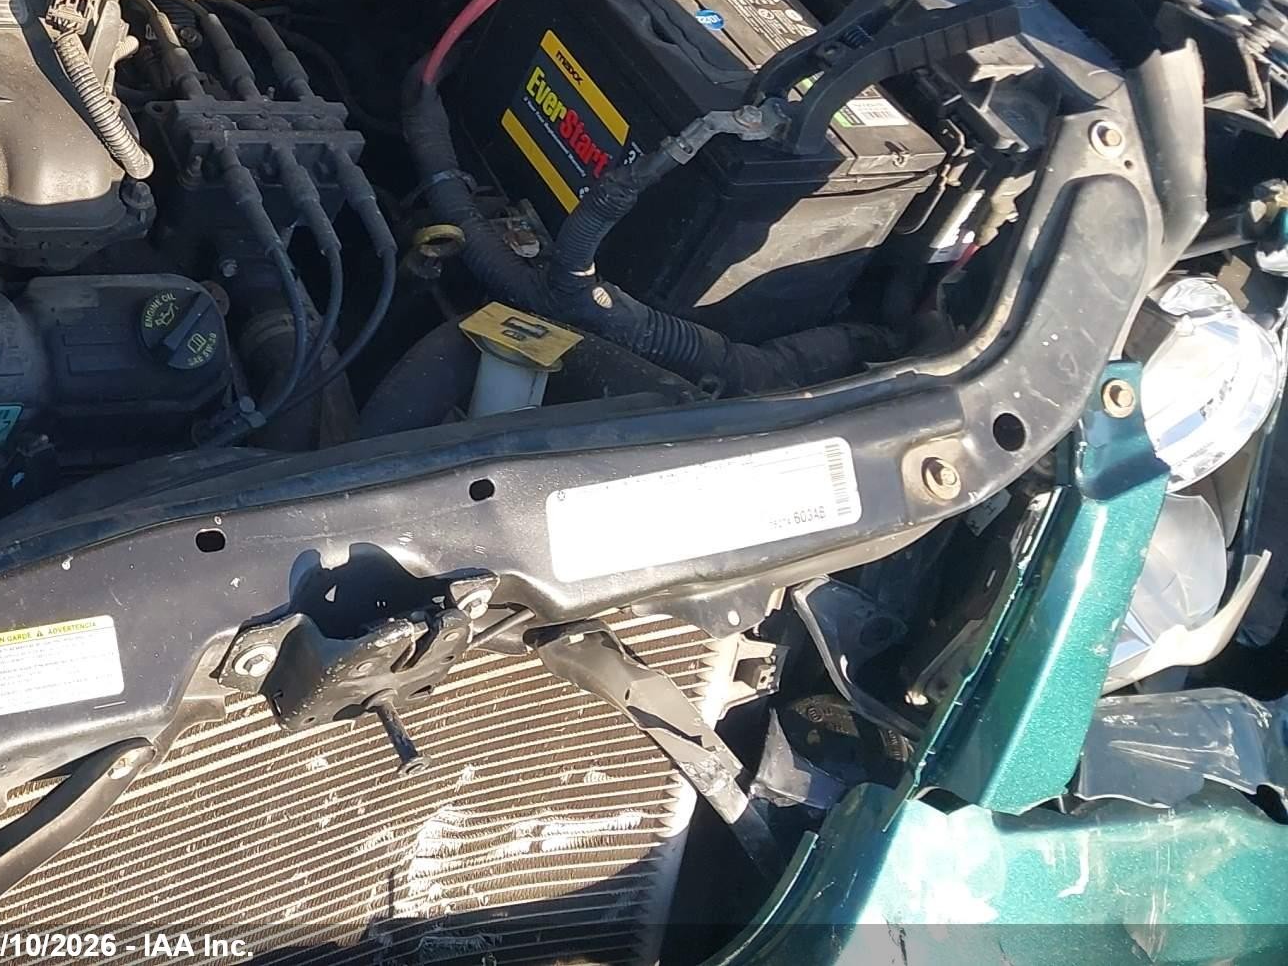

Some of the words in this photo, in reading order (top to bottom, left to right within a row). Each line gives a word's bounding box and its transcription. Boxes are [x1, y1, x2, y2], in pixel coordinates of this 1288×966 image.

[526, 66, 608, 178] EverStart
[144, 298, 163, 328] ENGINE
[161, 292, 177, 302] OIL
[6, 631, 32, 643] GARDE
[48, 622, 97, 635] ADVERTENCIA
